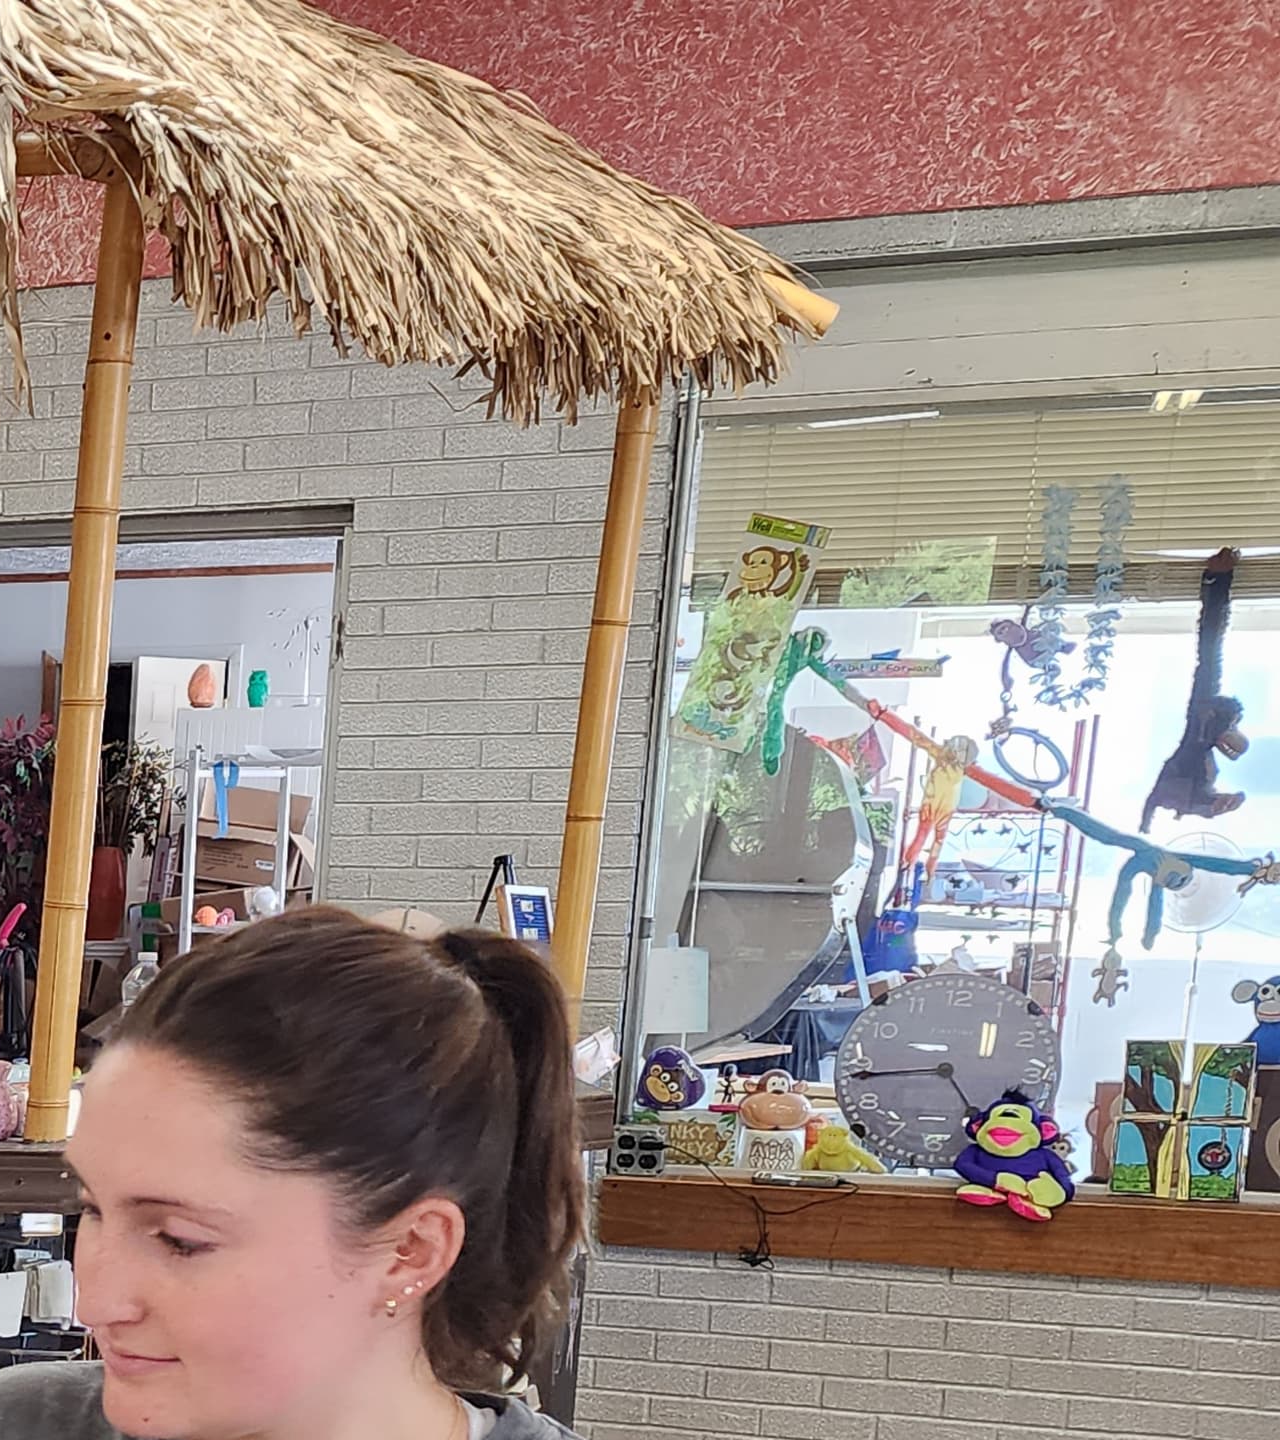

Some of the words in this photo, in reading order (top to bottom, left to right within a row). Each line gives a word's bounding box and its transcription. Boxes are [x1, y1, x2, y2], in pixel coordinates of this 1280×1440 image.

[909, 998, 927, 1014] 11
[945, 990, 973, 1008] 12
[873, 1022, 899, 1039] 10
[1015, 1031, 1036, 1049] 2
[858, 1093, 880, 1111] 8
[888, 1121, 908, 1139] 7
